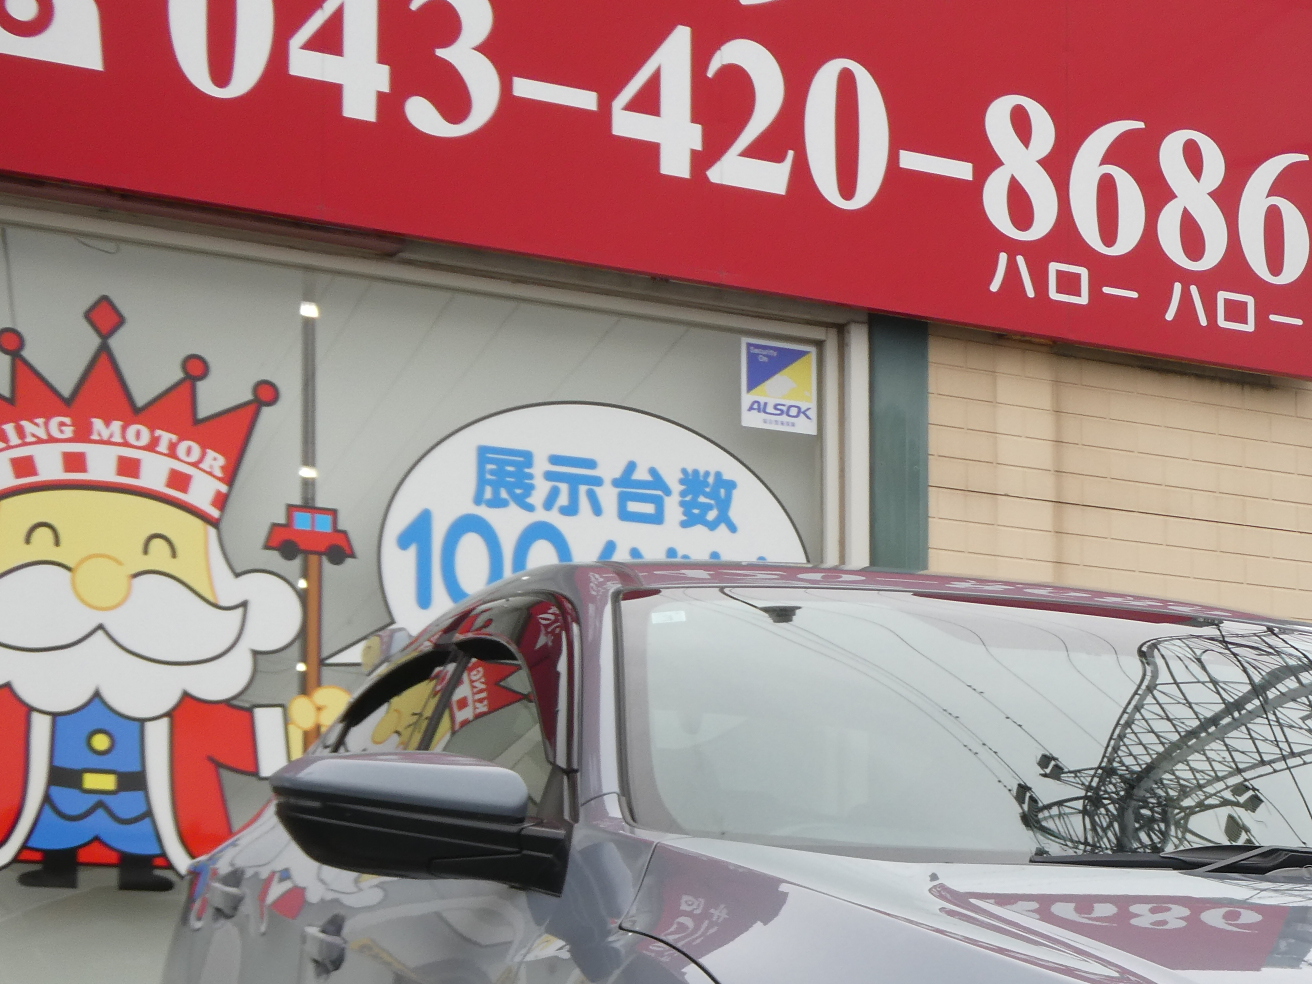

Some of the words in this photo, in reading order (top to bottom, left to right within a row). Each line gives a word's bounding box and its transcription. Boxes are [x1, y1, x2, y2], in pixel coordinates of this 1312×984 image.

[990, 252, 1139, 305] ハロー
[1165, 281, 1304, 332] ハロー
[747, 400, 813, 421] ALSOK
[0, 416, 75, 449] ING
[90, 417, 227, 478] MOTOR
[473, 444, 738, 534] 展示台数
